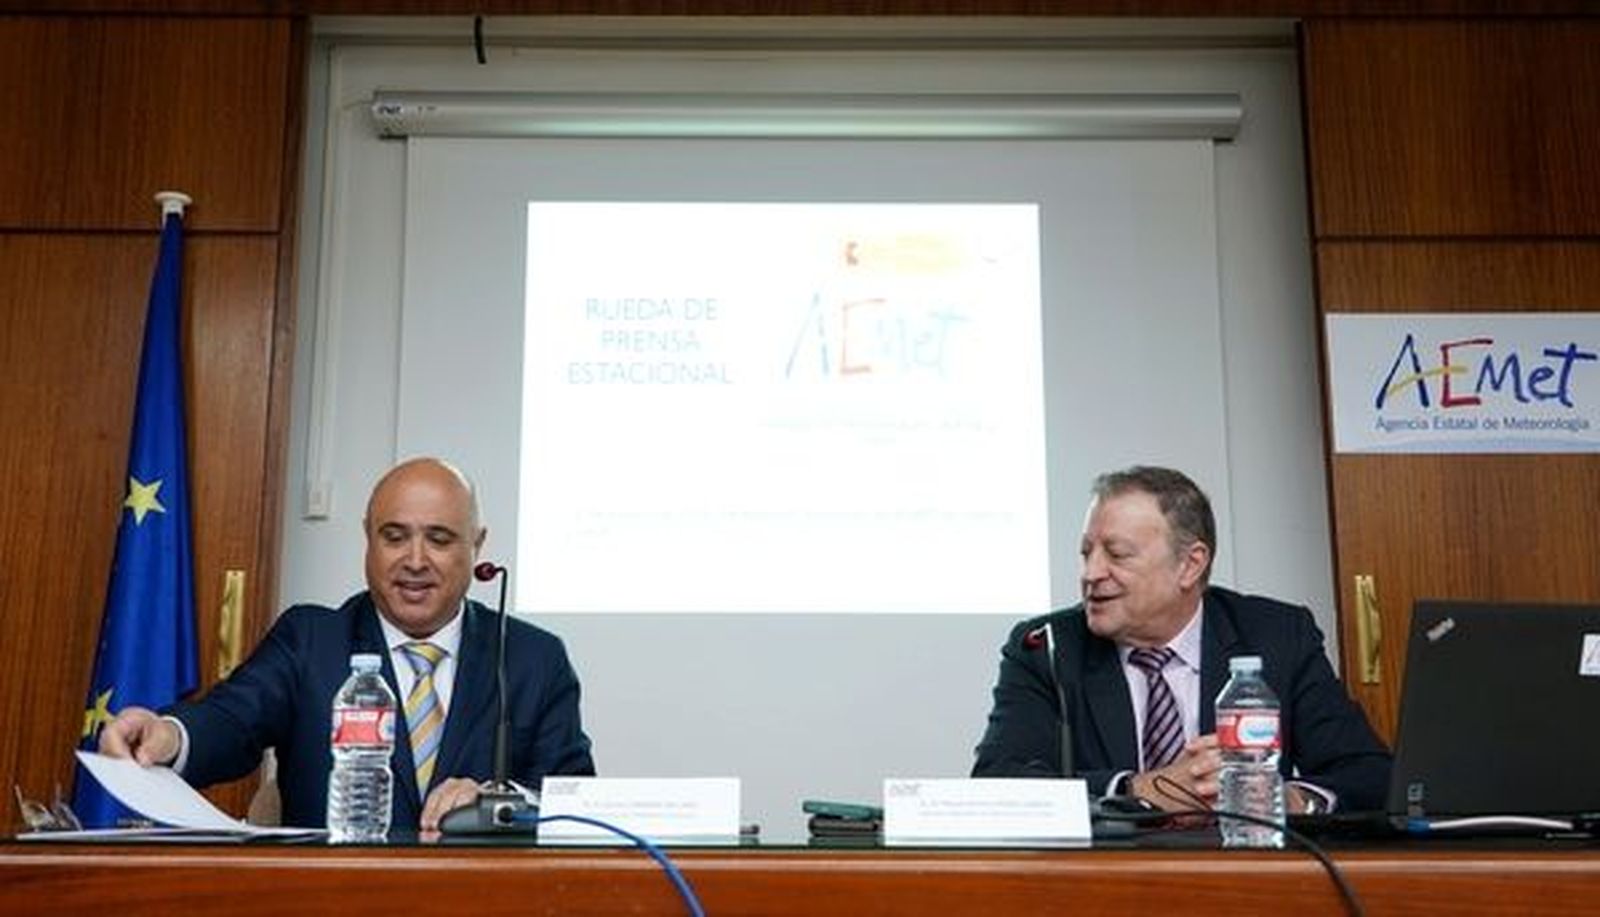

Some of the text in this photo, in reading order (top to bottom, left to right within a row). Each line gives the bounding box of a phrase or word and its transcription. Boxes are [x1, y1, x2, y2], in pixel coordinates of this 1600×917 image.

[586, 297, 719, 321] RUEDA DE
[601, 329, 702, 353] PRENSA
[568, 361, 733, 385] ESTACIONAL
[1376, 334, 1599, 409] AEMet
[1376, 417, 1428, 433] Agencia
[1434, 417, 1478, 430] Estatal
[1482, 417, 1499, 430] de
